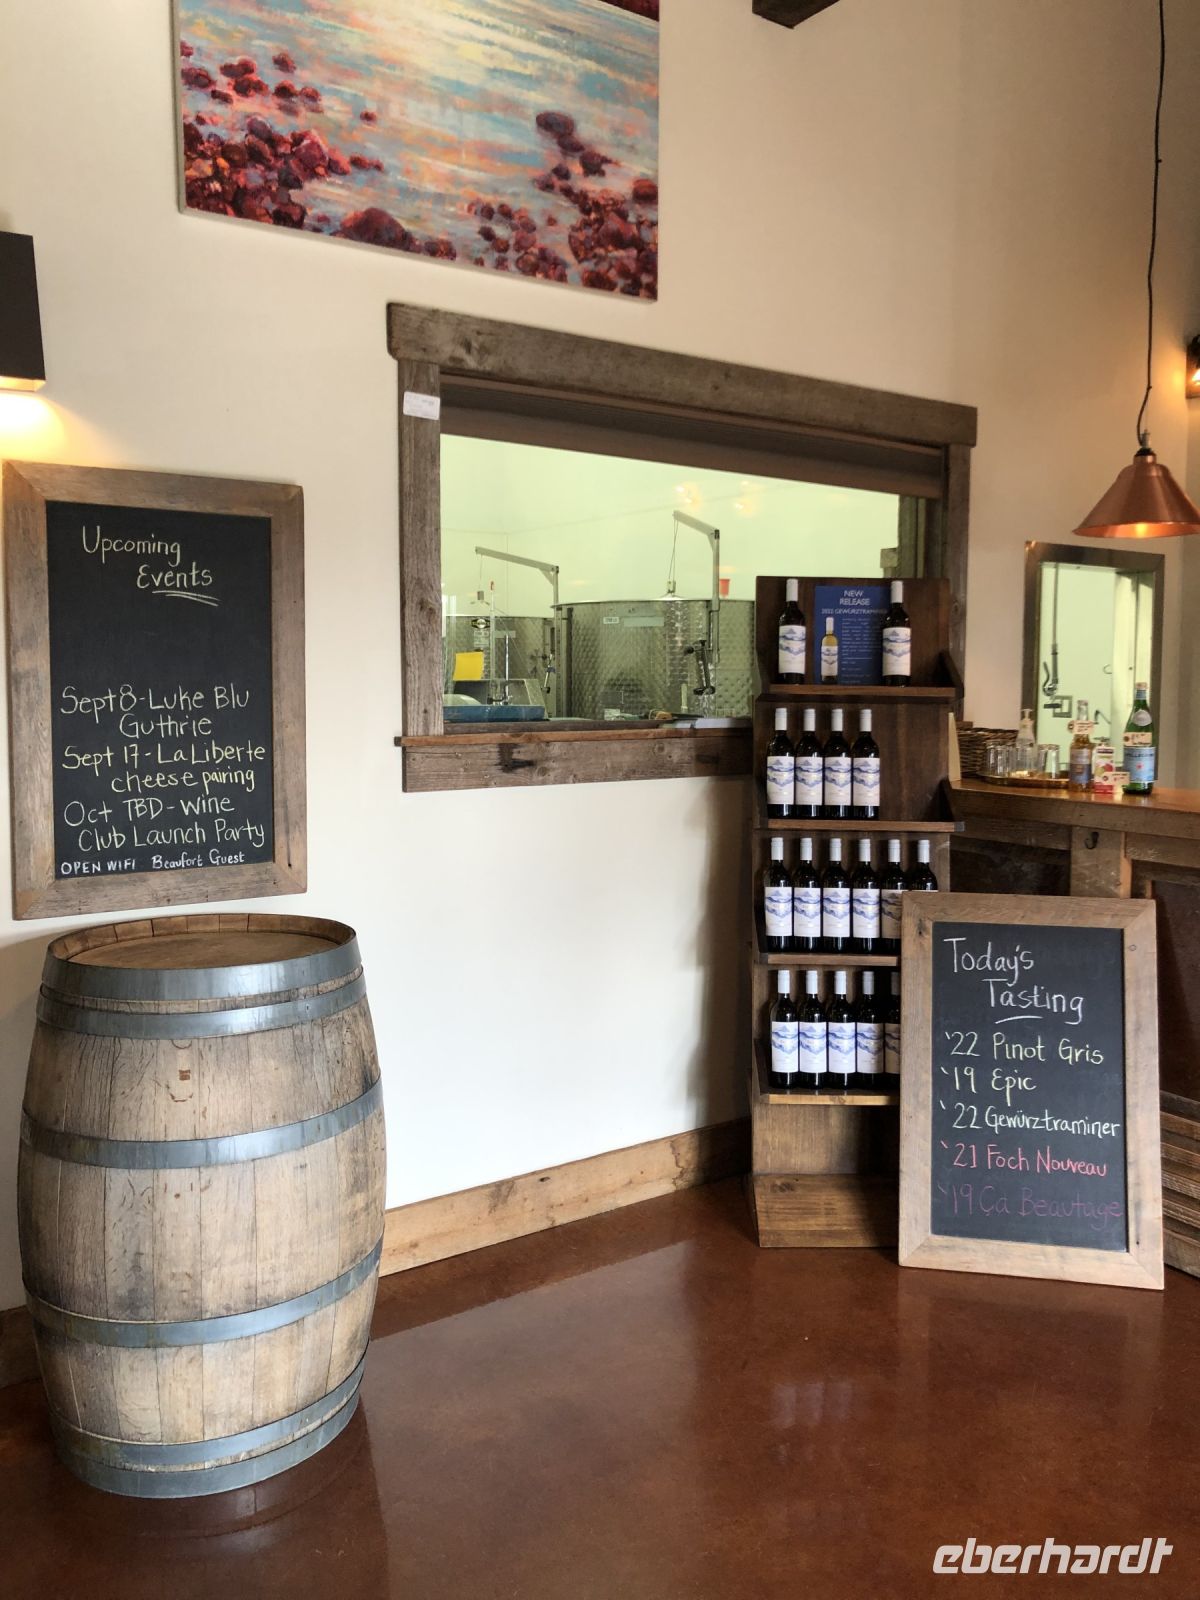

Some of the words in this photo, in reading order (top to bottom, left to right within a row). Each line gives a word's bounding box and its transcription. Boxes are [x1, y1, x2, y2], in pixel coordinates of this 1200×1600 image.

[82, 525, 181, 568] Upcoming
[136, 561, 213, 589] Events
[840, 598, 870, 606] RELEASE
[213, 683, 249, 710] Blu
[119, 713, 213, 739] Guthrie
[62, 745, 115, 777] Sept
[111, 771, 199, 794] cheese
[201, 767, 256, 795] pairing
[63, 800, 113, 827] Oct
[78, 825, 126, 852] Club
[133, 821, 206, 848] Launch
[214, 818, 265, 848] Party
[60, 860, 101, 875] OPEN
[106, 858, 136, 872] WIFI
[151, 851, 204, 870] Beaufort
[208, 848, 246, 866] Guest
[943, 937, 1035, 987] Today's
[981, 977, 1084, 1025] Tasting
[992, 1031, 1047, 1062] Pinot
[1057, 1038, 1105, 1066] Gris
[991, 1067, 1037, 1107] Epic
[984, 1105, 1121, 1139] Gewürztraminer
[986, 1143, 1030, 1171] Foch
[1036, 1145, 1107, 1177] Nouveau
